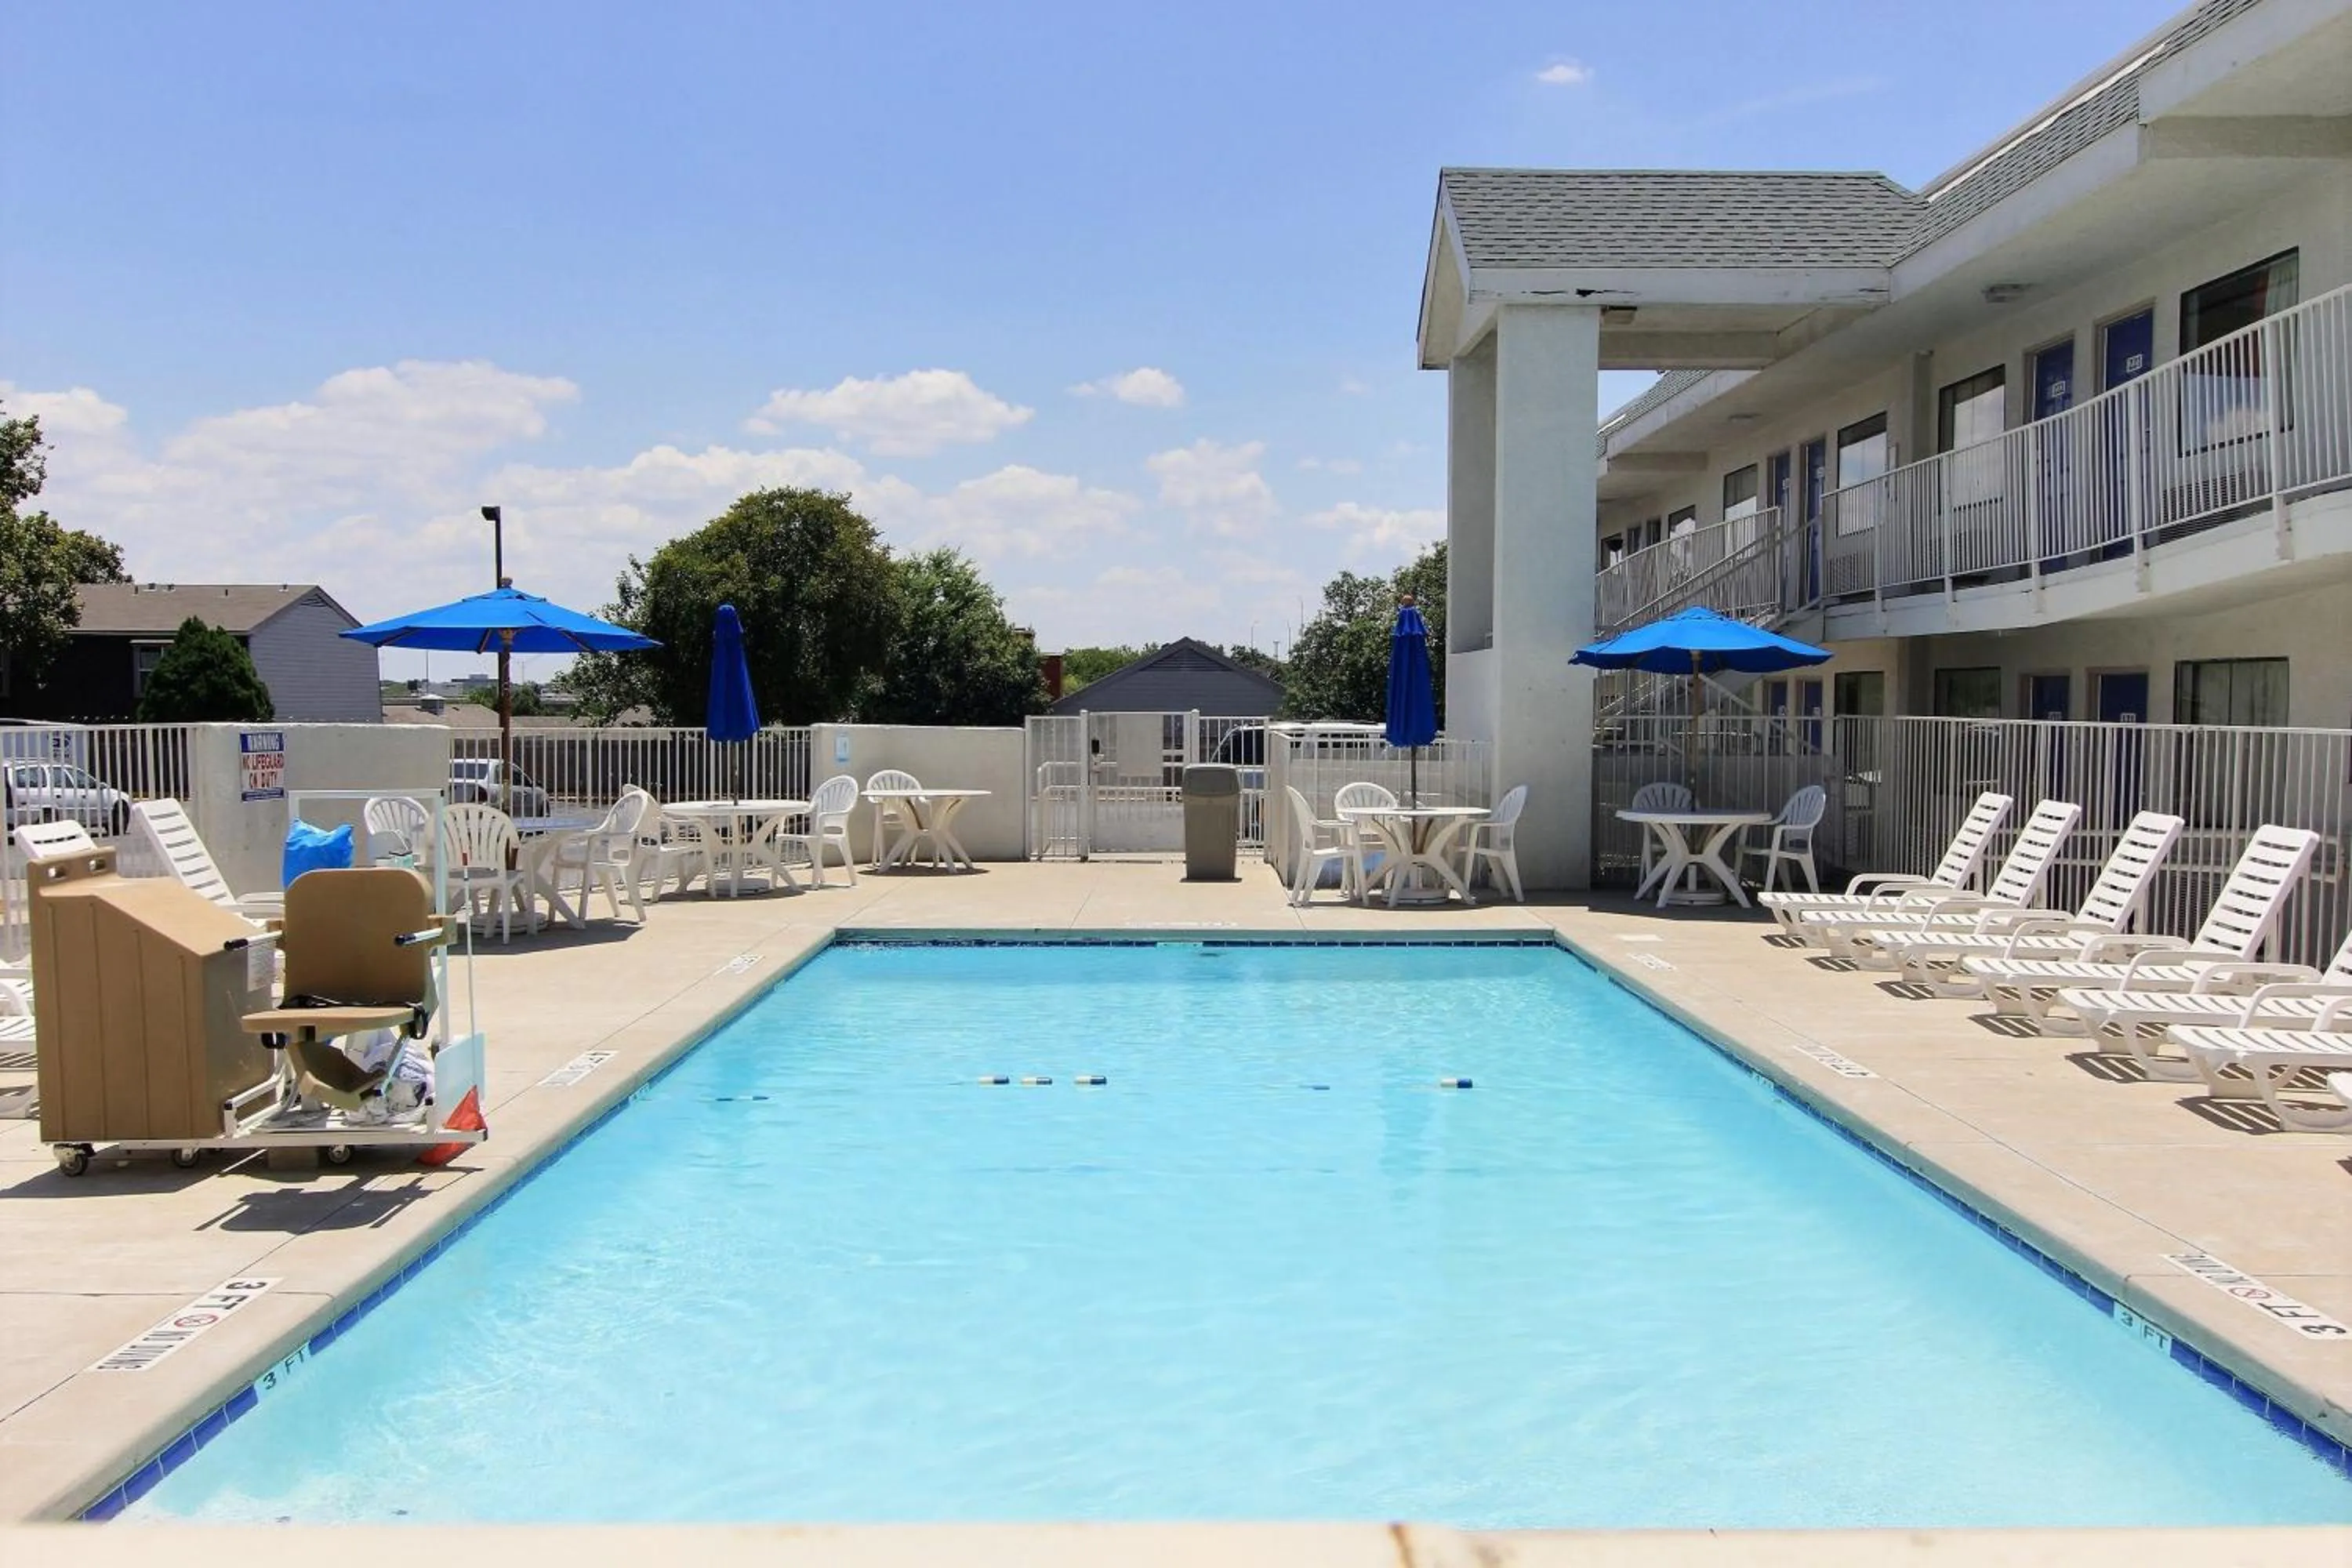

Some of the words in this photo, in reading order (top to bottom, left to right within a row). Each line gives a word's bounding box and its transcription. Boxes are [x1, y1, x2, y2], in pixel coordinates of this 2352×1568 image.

[247, 734, 279, 750] WARNING
[252, 753, 284, 769] LIFEGUARD
[261, 771, 277, 788] DUTY
[225, 1281, 267, 1290] 3
[193, 1294, 250, 1310] FT
[2258, 1301, 2321, 1319] FT
[2121, 1311, 2133, 1327] 3
[2143, 1323, 2170, 1349] FT
[2299, 1323, 2347, 1335] 3
[263, 1372, 276, 1390] 3
[284, 1348, 307, 1374] FT
